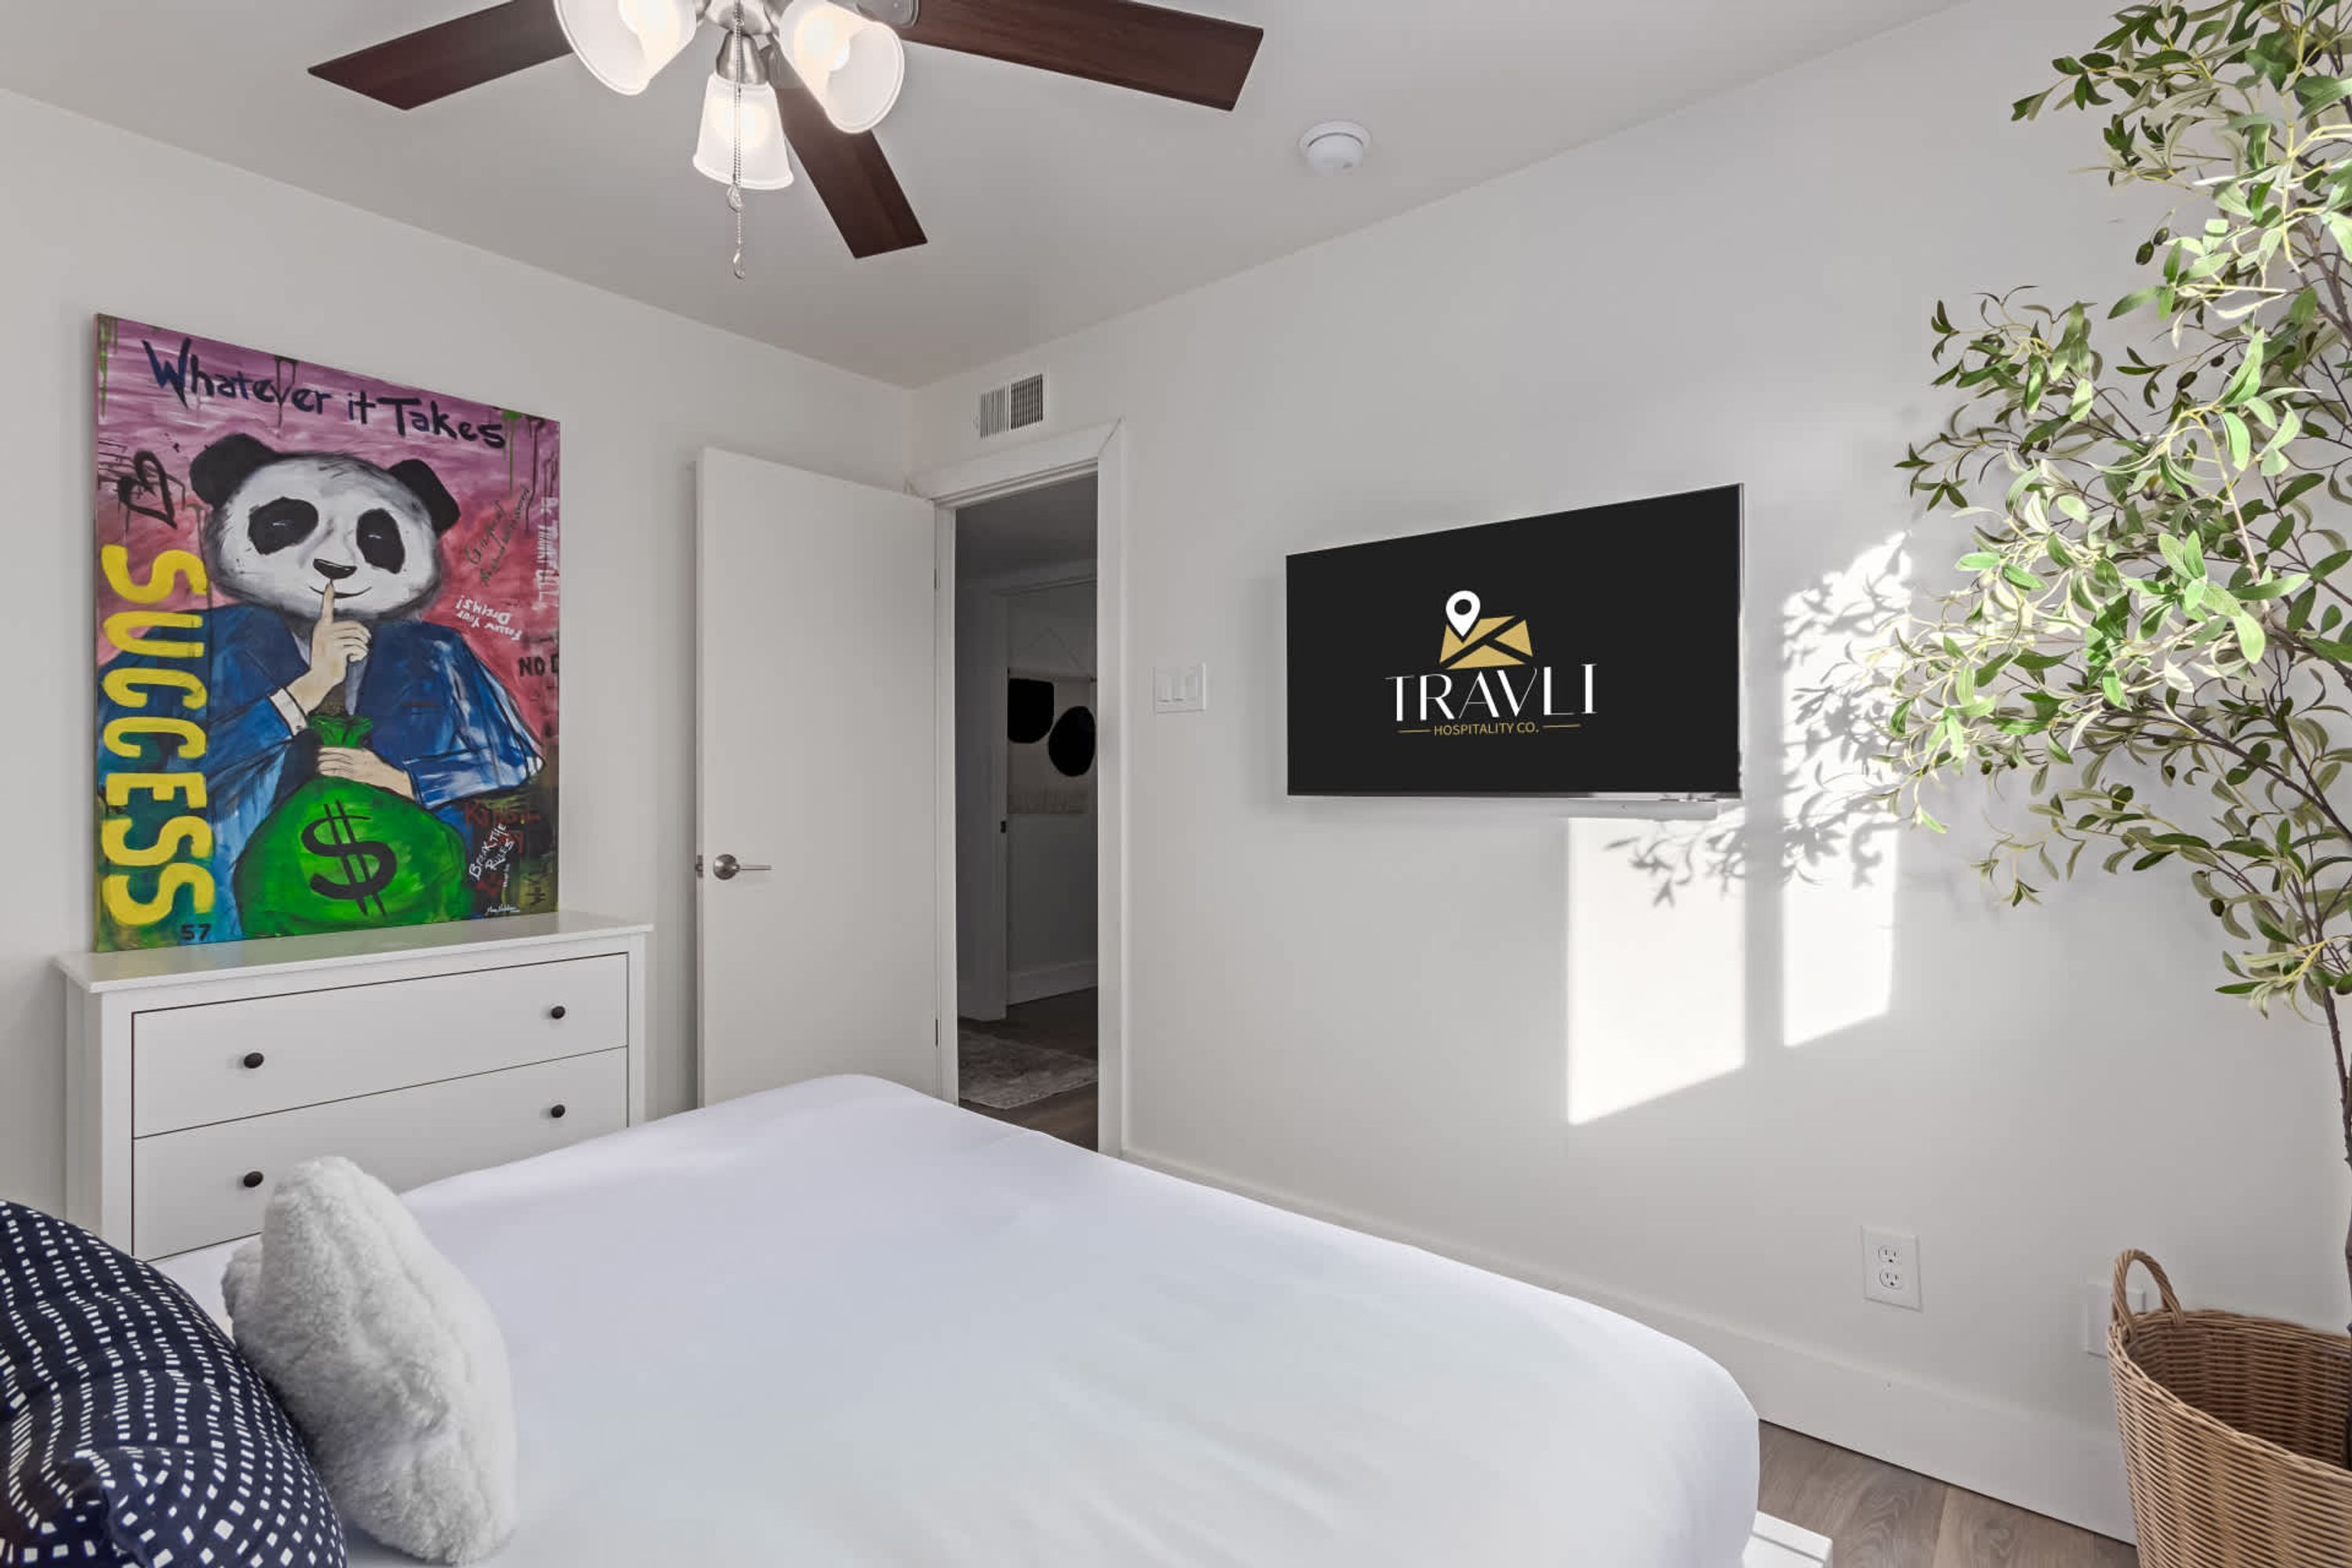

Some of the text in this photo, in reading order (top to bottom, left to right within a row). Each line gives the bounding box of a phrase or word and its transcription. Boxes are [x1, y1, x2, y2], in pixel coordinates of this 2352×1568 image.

[142, 337, 506, 449] Whatever it Takes
[518, 655, 546, 677] NO
[1385, 663, 1598, 721] TRAVLI
[100, 544, 216, 926] SUCCESS
[1433, 720, 1540, 737] HOSPITALITY CO.
[489, 823, 510, 841] THE
[180, 923, 212, 942] 57
